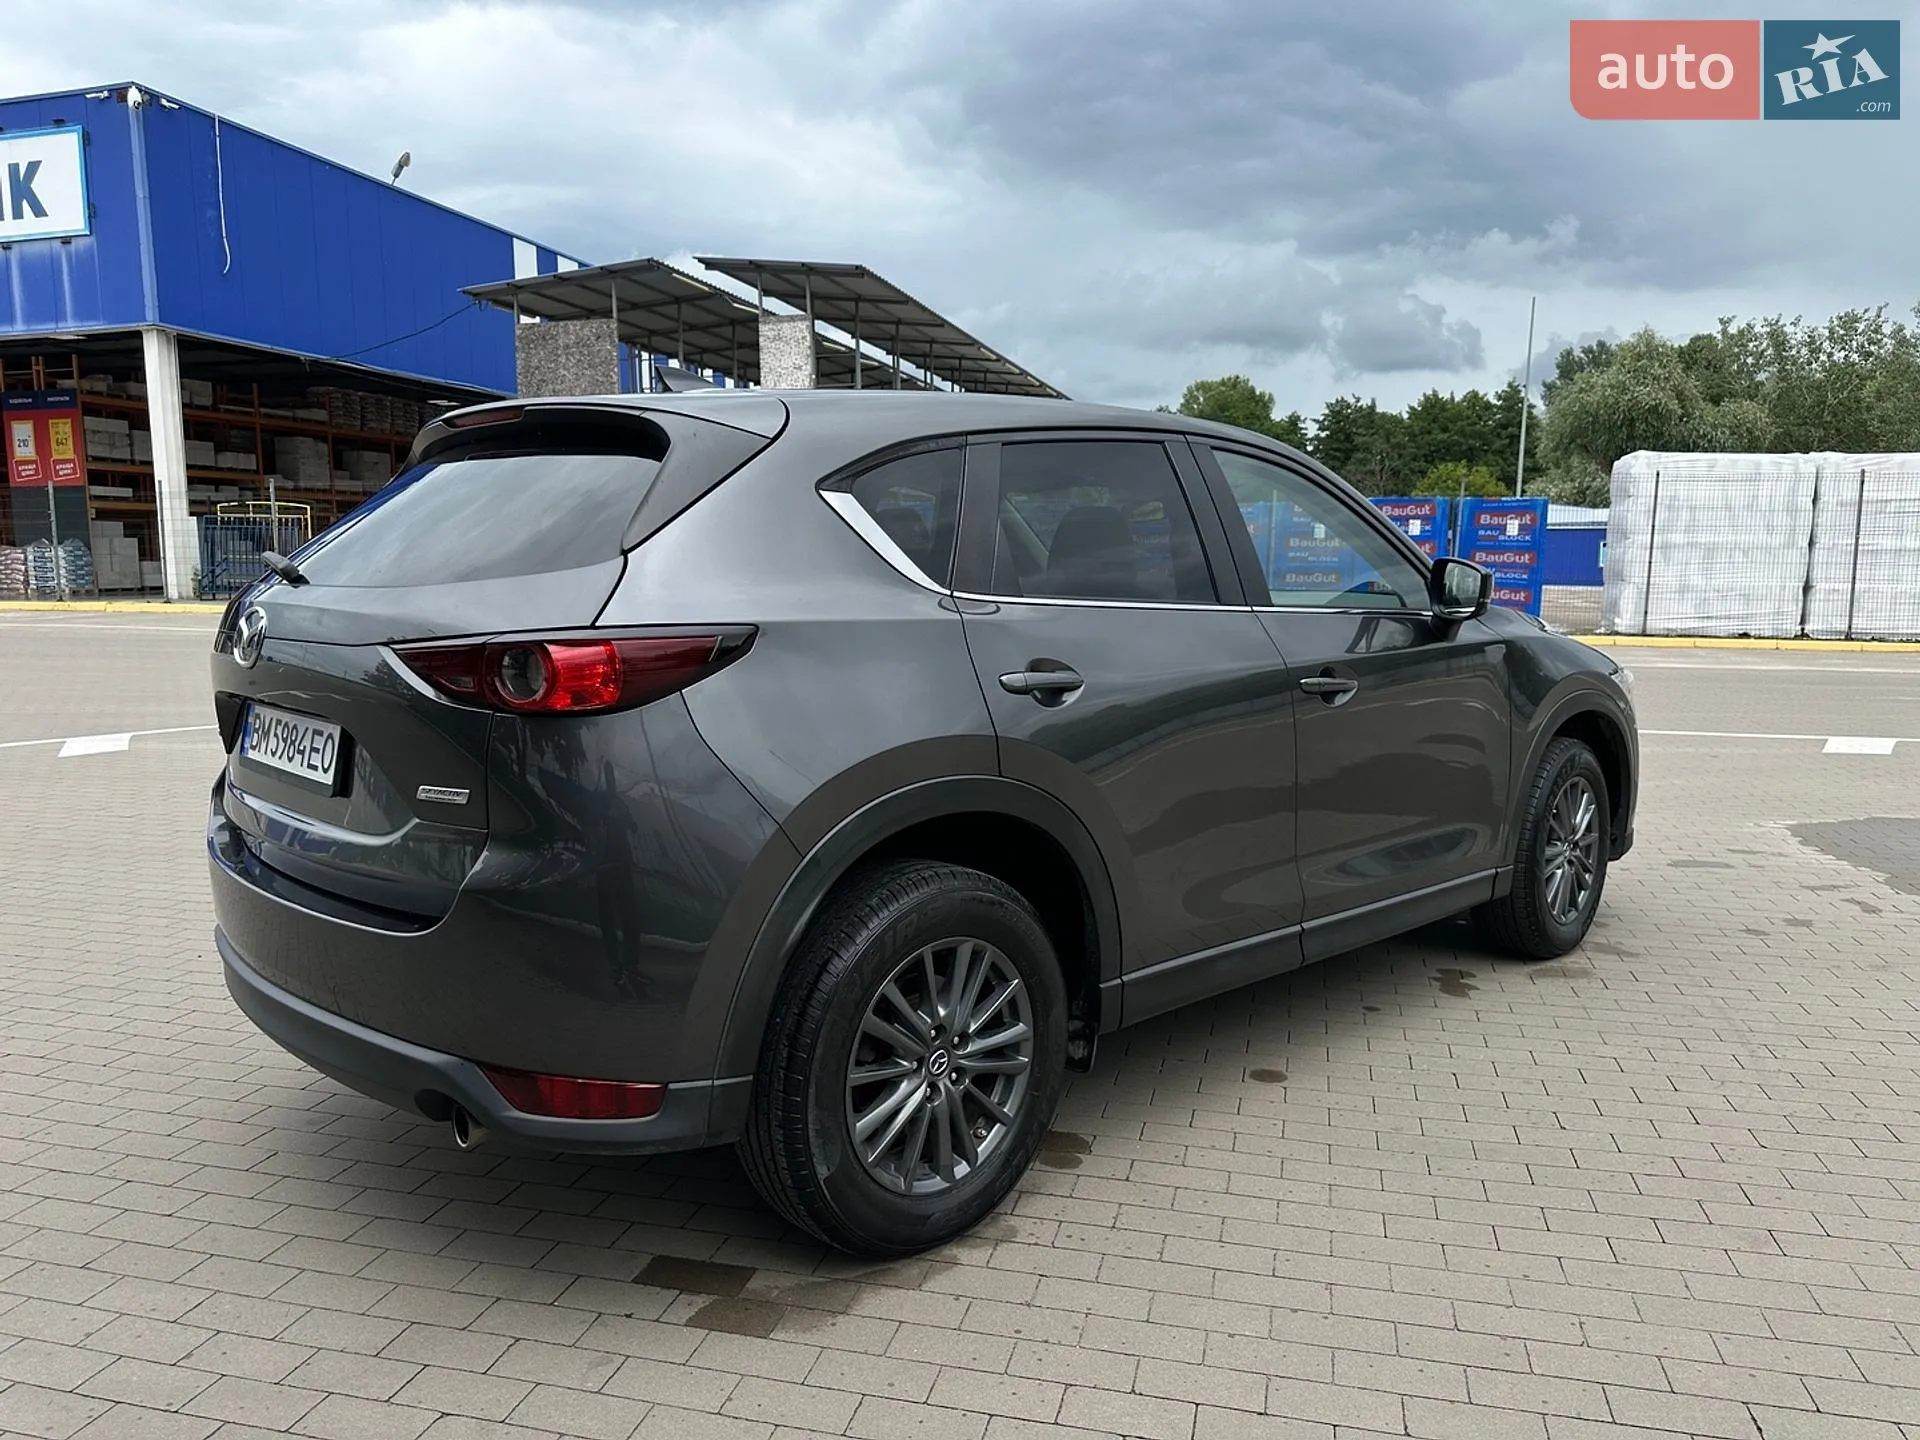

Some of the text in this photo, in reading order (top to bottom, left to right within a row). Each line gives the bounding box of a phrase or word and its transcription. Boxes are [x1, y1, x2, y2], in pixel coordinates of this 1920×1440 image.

[17, 438, 29, 448] 210
[1382, 504, 1431, 516] BauGut
[1289, 537, 1340, 547] BauGut
[1475, 552, 1531, 563] BauGut
[1285, 572, 1336, 583] BauGut
[1491, 589, 1526, 601] uGut
